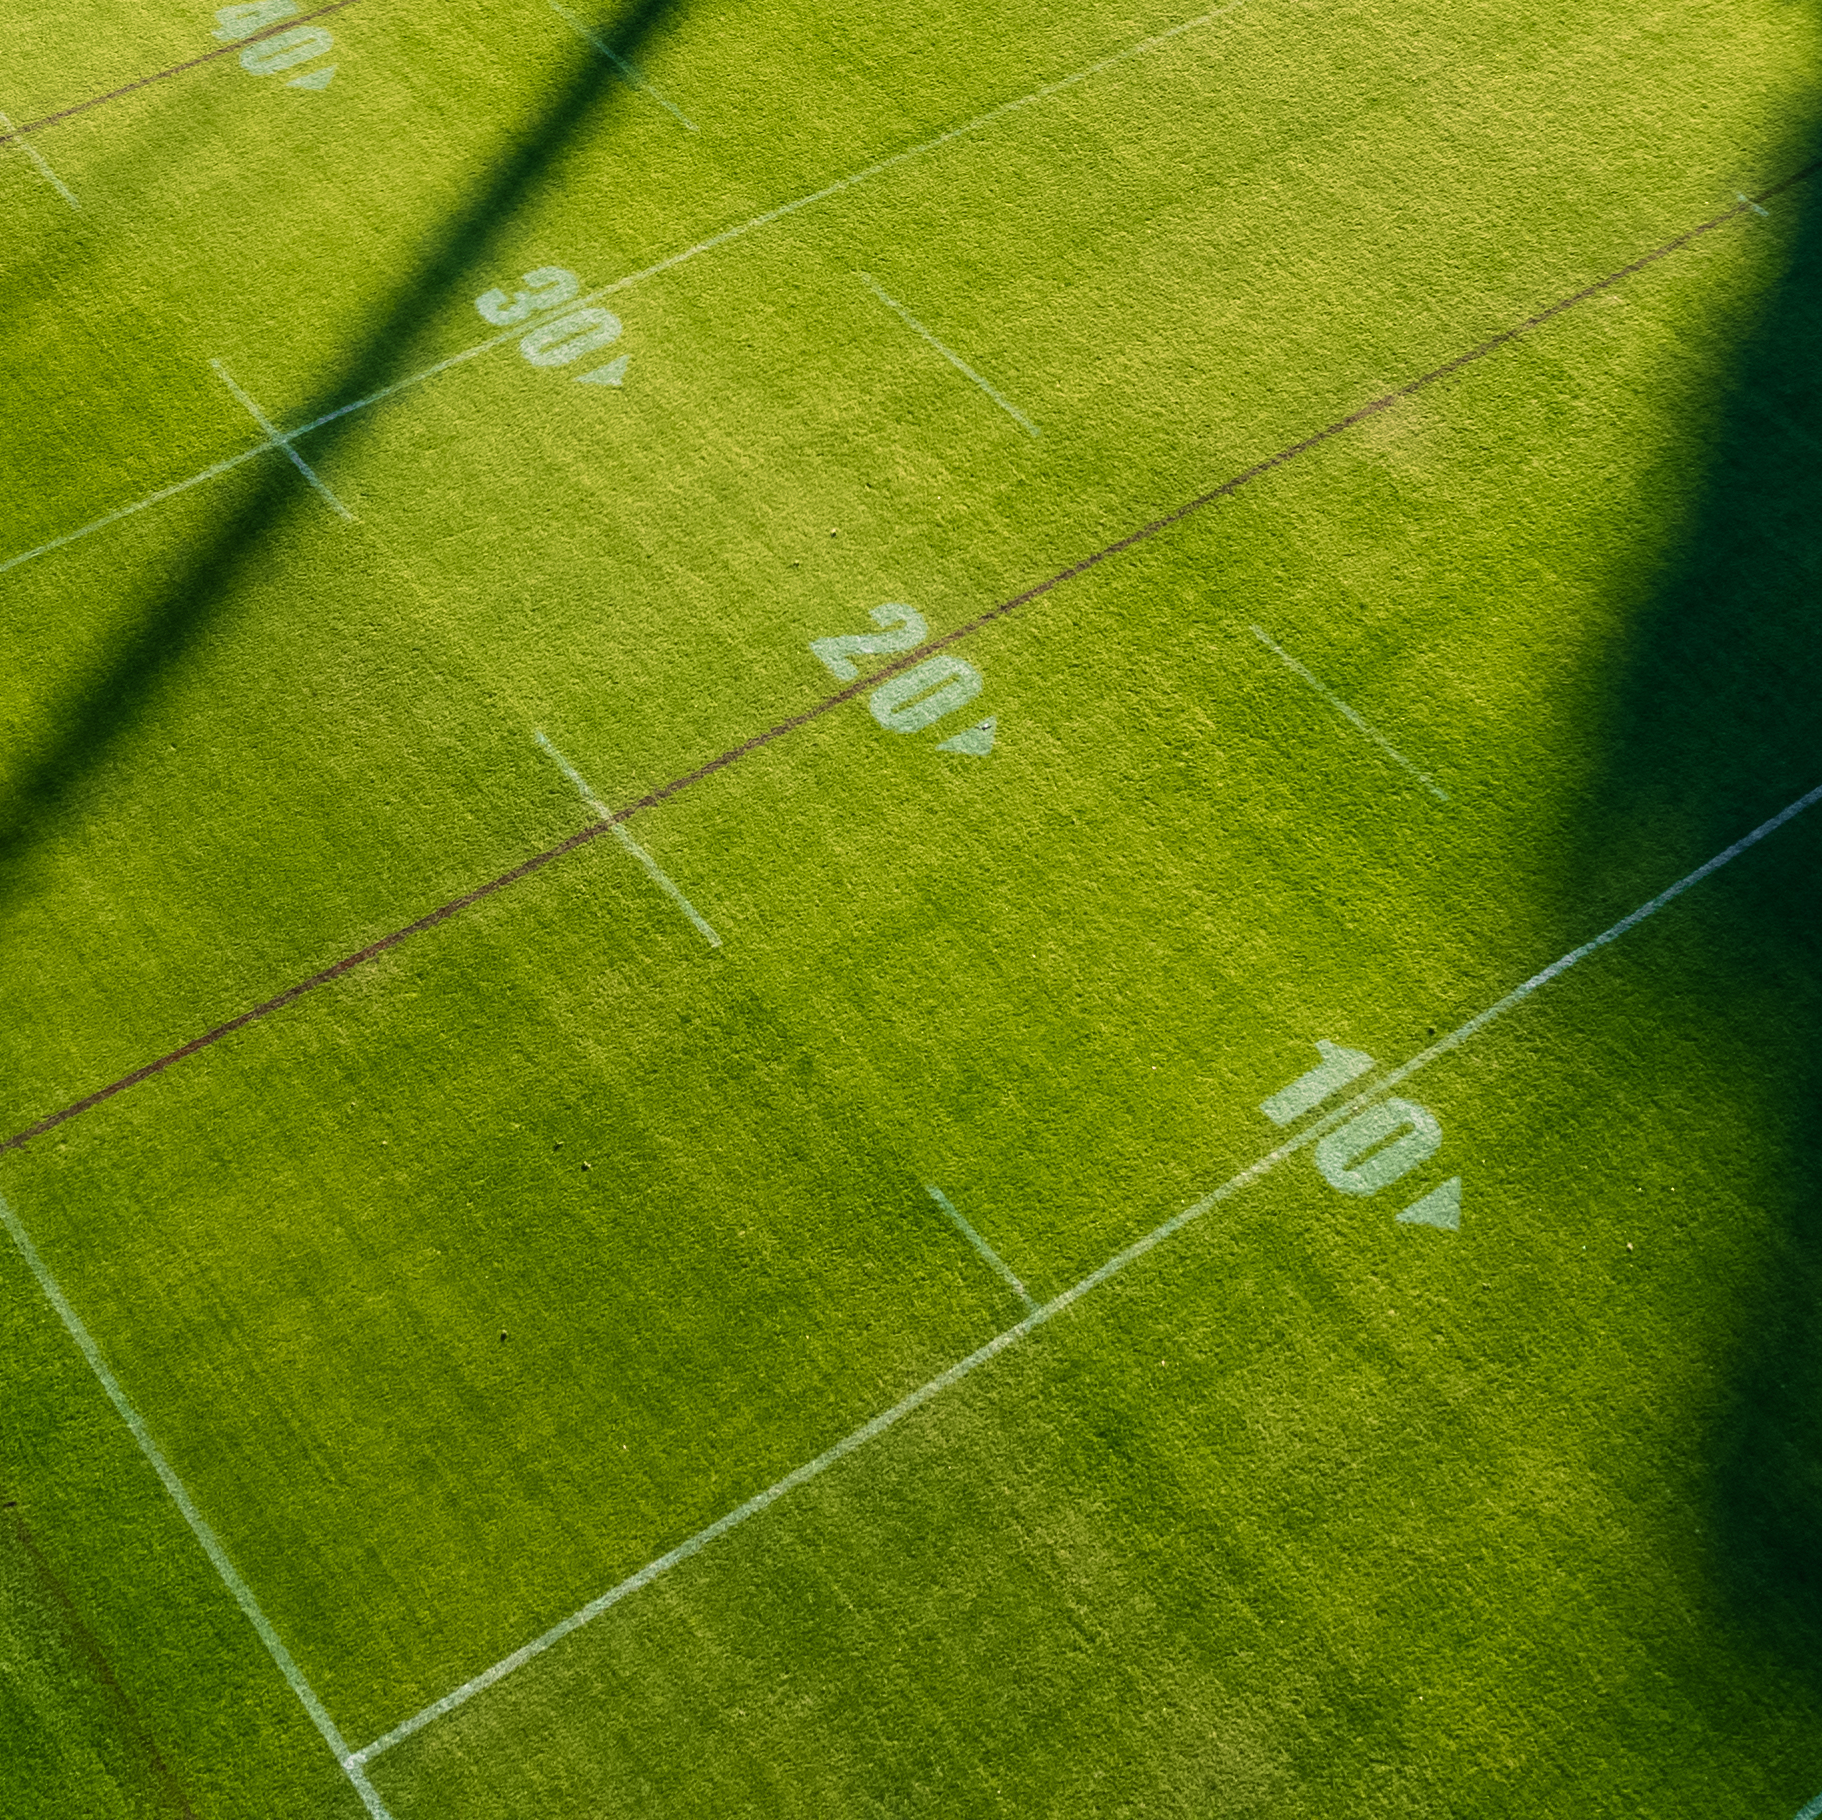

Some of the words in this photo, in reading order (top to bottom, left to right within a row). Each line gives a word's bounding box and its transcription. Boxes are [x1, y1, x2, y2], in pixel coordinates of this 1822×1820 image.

[475, 265, 623, 367] 30
[809, 602, 983, 734] 20
[1259, 1039, 1443, 1197] 10
